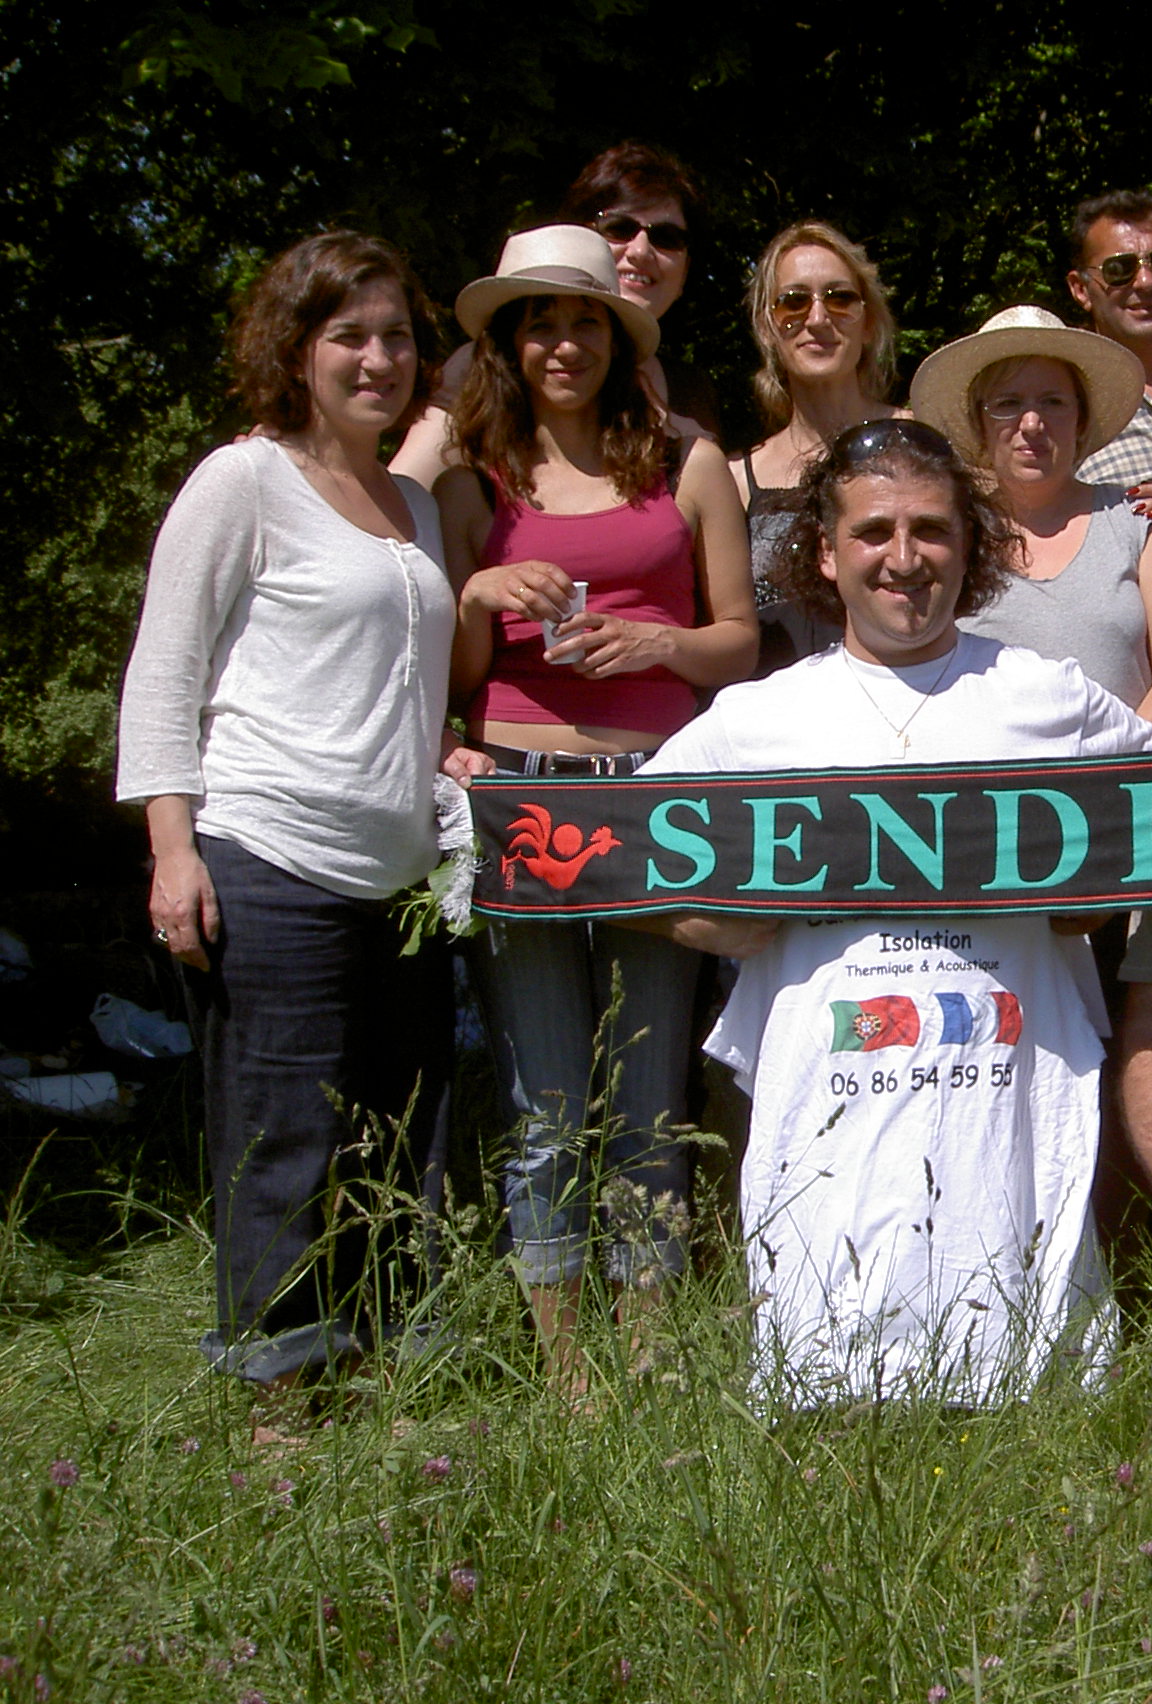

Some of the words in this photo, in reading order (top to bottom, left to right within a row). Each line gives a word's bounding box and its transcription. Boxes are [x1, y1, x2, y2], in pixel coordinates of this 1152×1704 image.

[879, 929, 972, 953] Isolation
[845, 962, 914, 978] Thermique
[920, 959, 929, 972] &
[936, 957, 1000, 973] Acoustique
[830, 1072, 859, 1096] 06
[871, 1069, 898, 1094] 86
[911, 1067, 939, 1091] 54
[950, 1064, 979, 1088] 59
